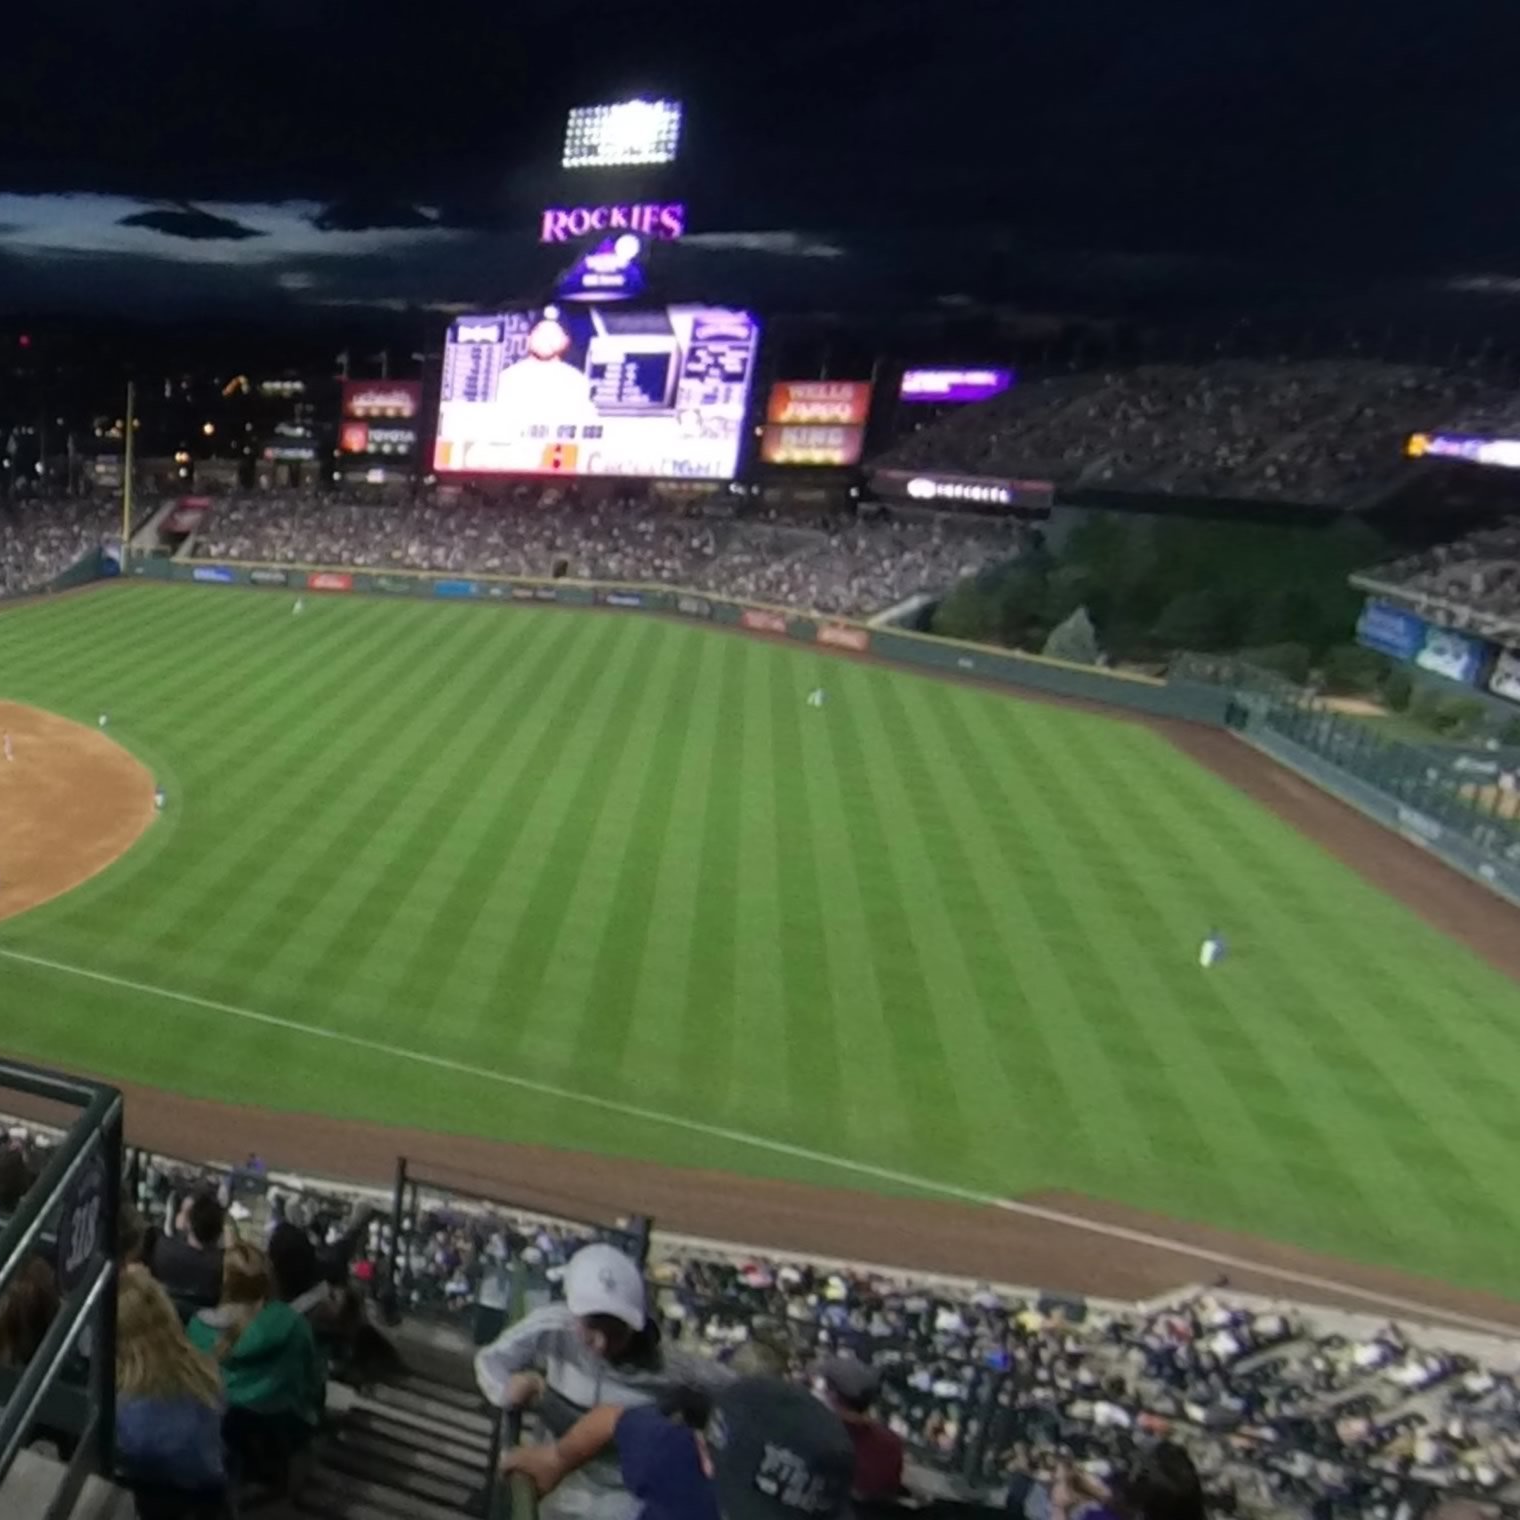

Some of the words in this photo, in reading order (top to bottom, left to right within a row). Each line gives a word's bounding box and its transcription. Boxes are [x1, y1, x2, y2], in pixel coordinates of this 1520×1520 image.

[540, 203, 684, 243] ROCKIES
[788, 384, 855, 400] WELLS
[368, 428, 417, 443] TOYOTA
